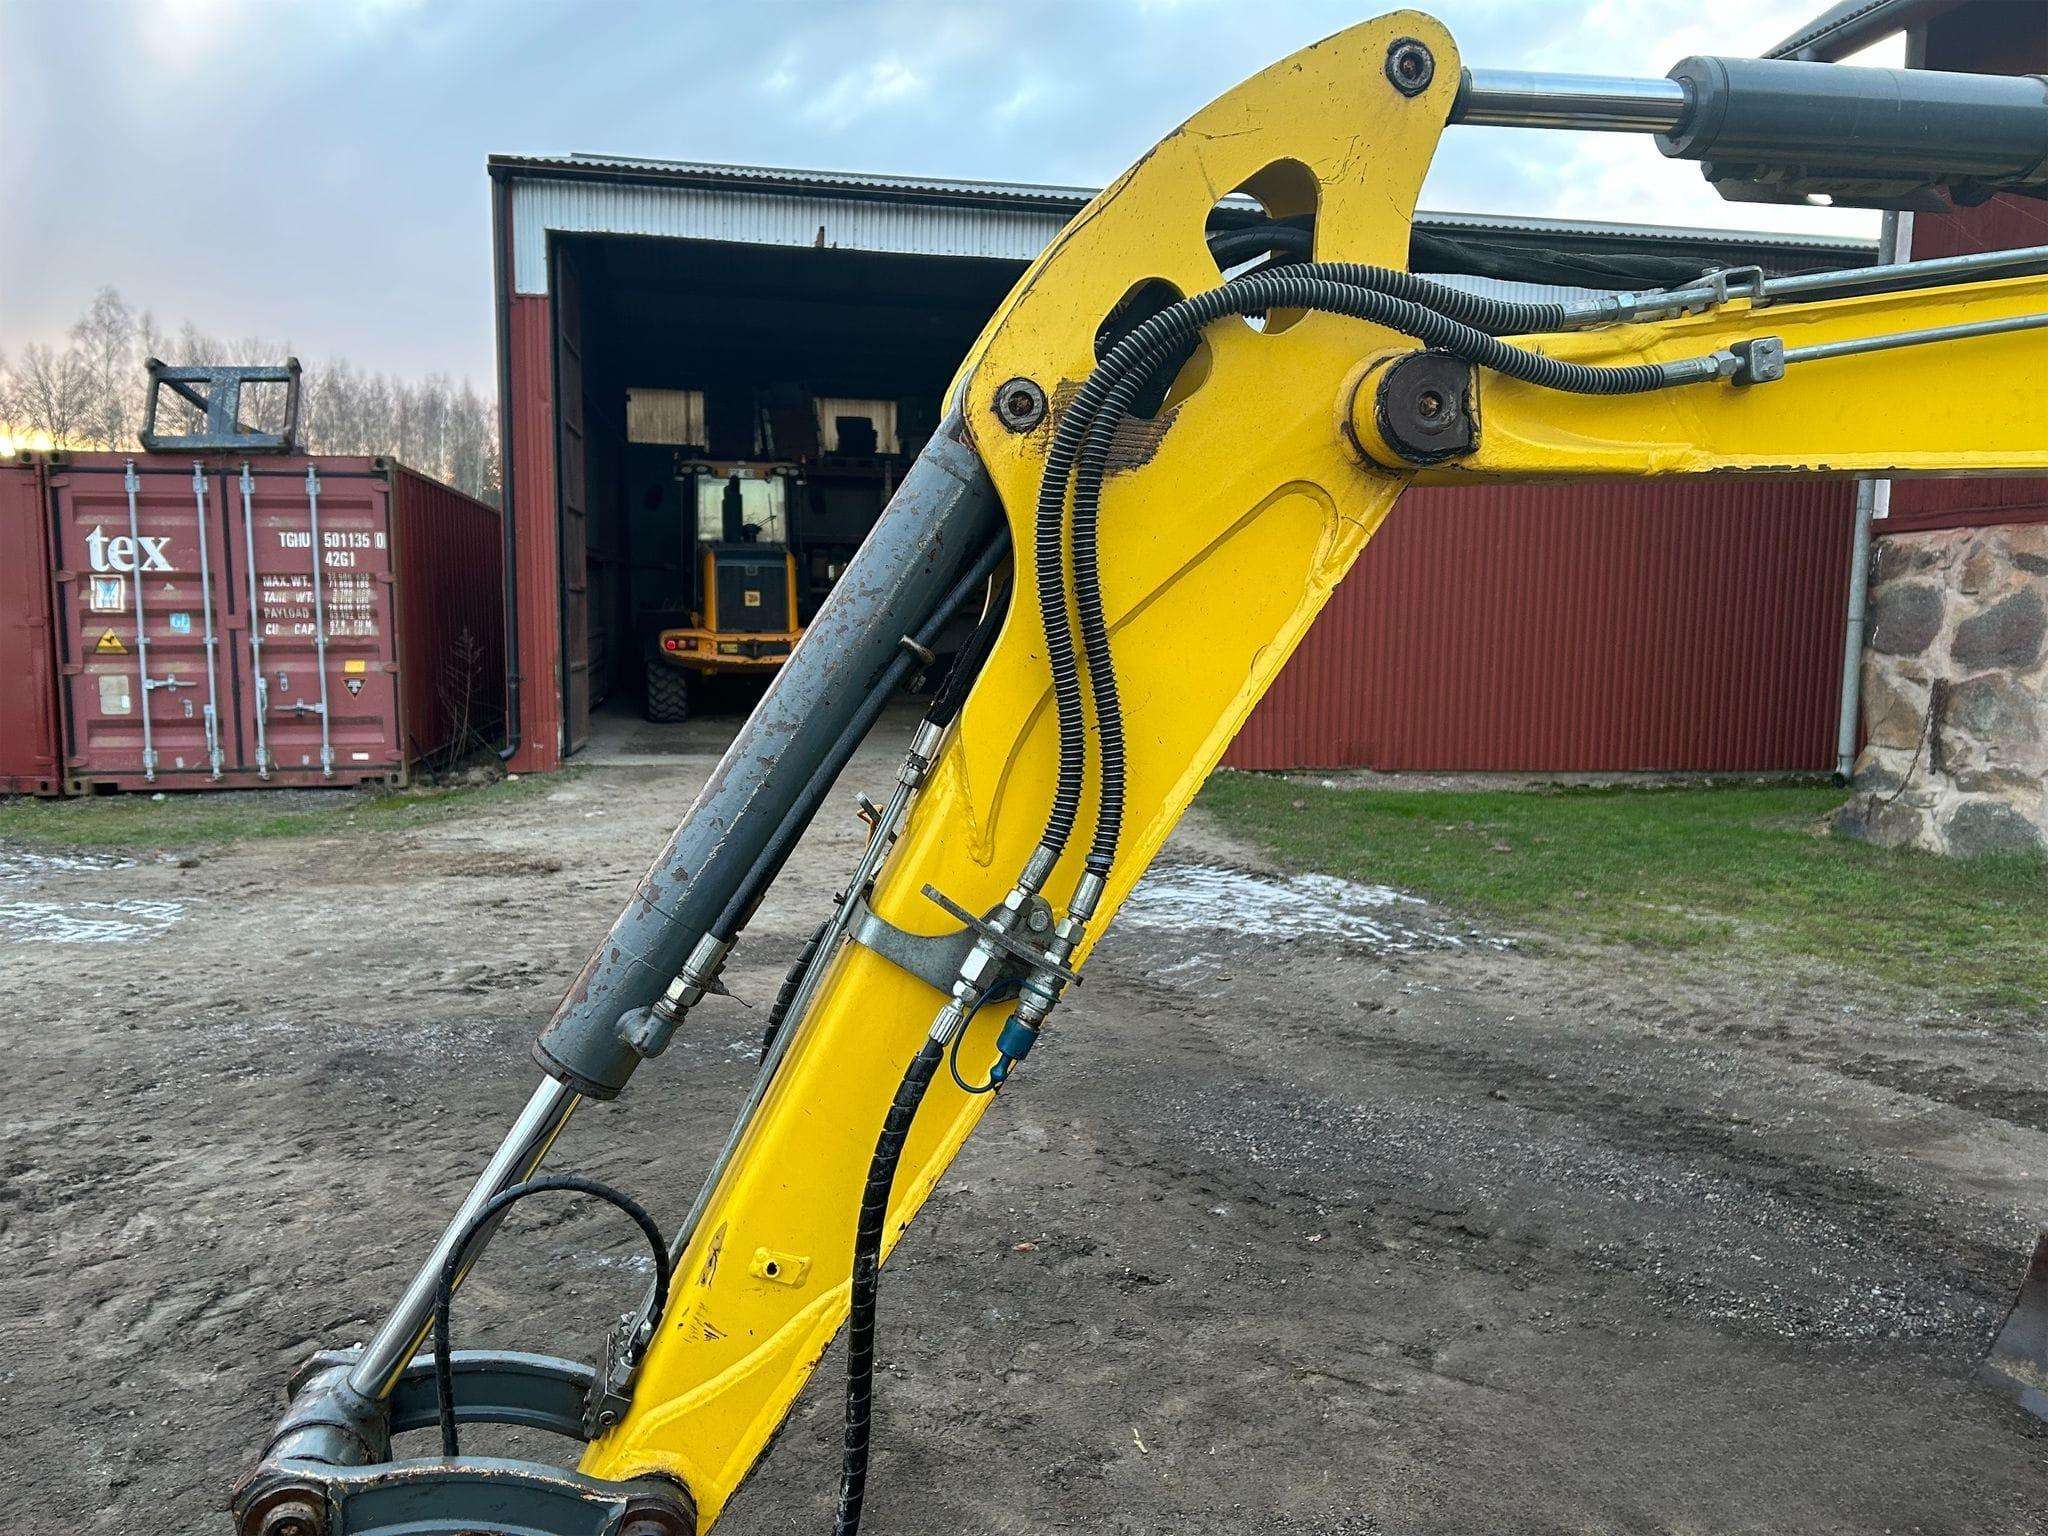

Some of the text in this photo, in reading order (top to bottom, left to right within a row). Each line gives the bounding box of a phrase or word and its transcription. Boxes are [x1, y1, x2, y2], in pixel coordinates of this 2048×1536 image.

[279, 532, 311, 548] TGHU
[85, 525, 175, 572] tex
[325, 551, 355, 567] 42G1
[263, 607, 310, 619] PAYLOAD
